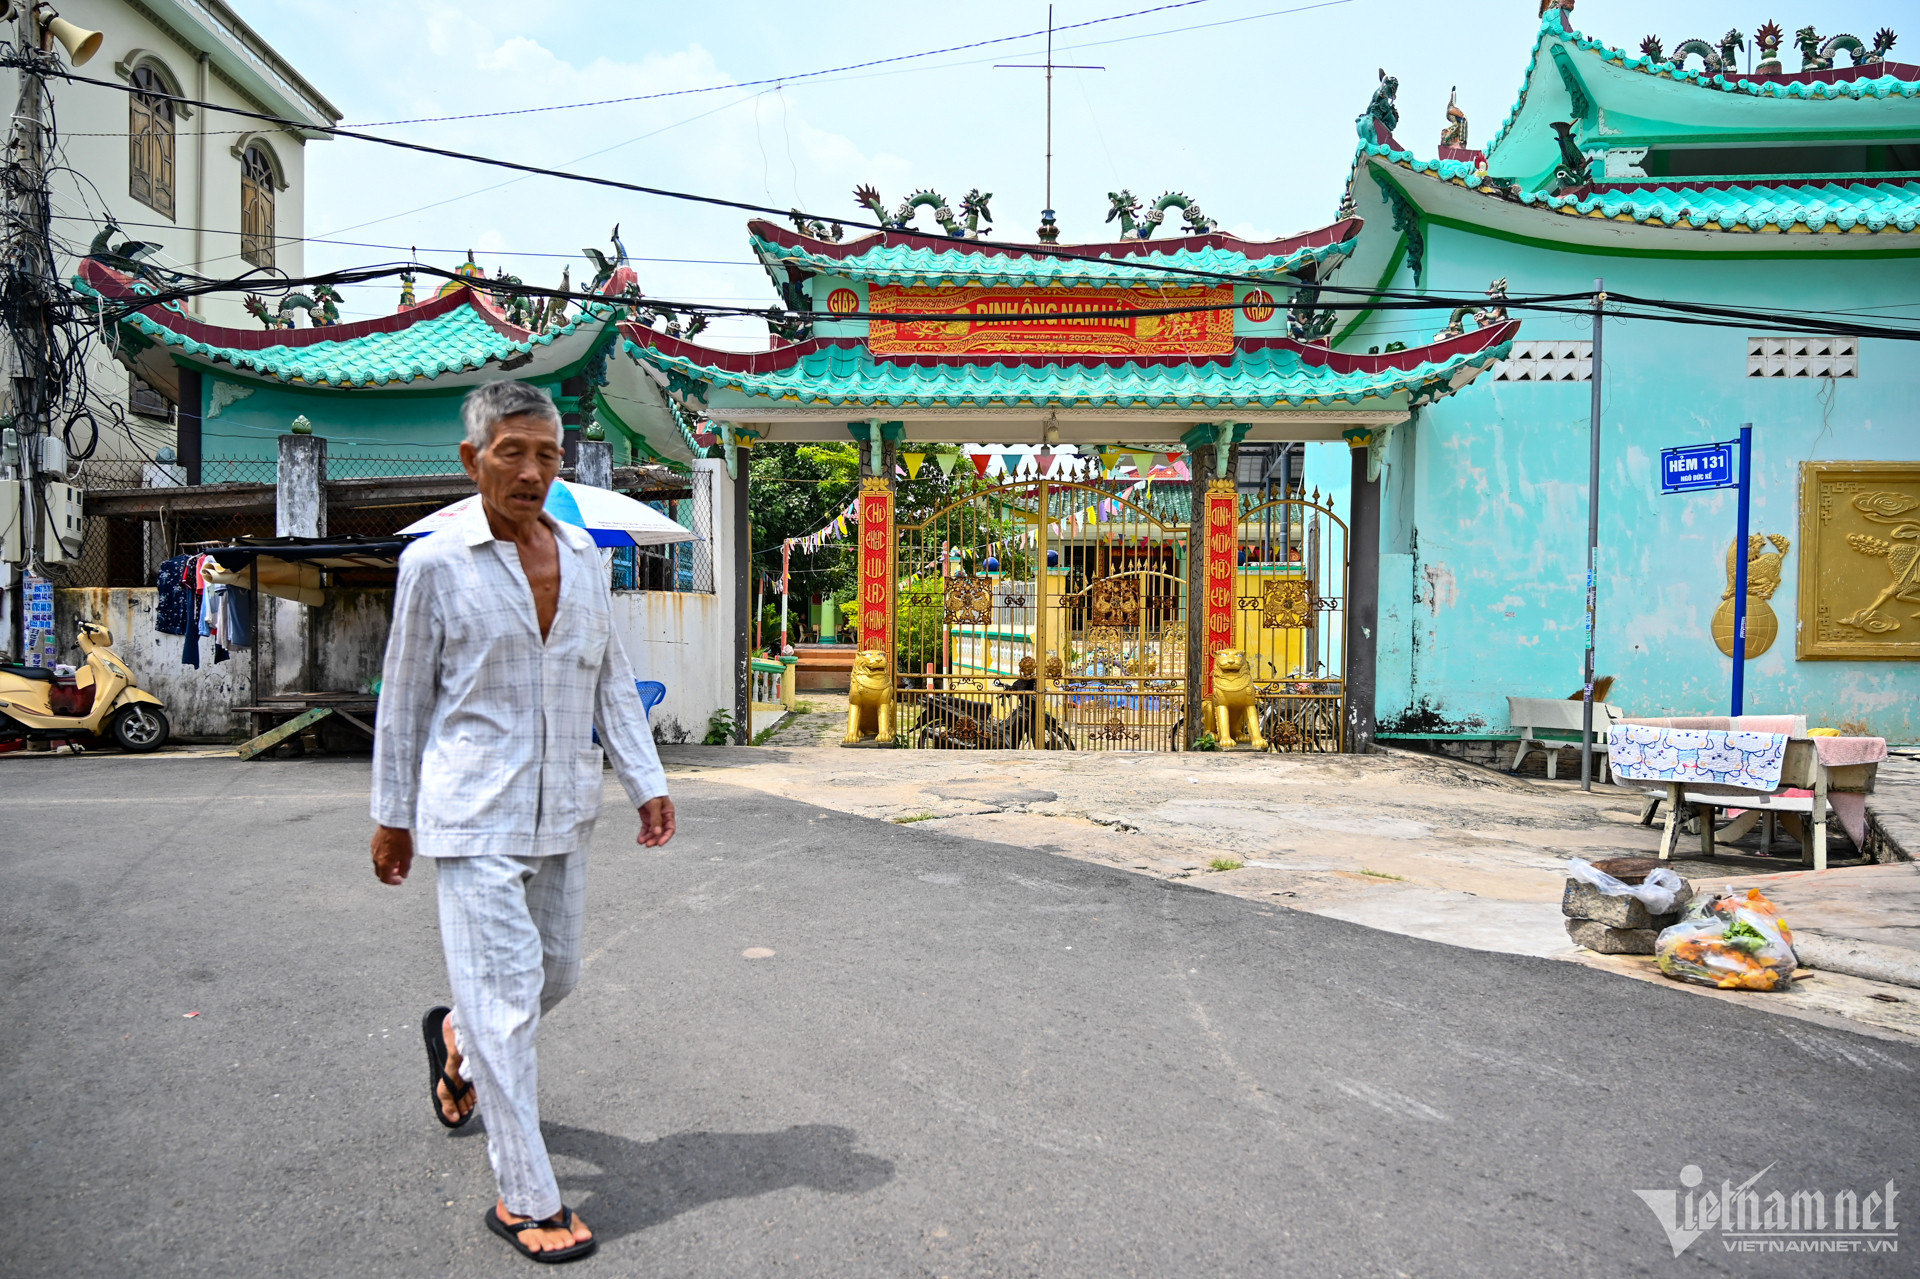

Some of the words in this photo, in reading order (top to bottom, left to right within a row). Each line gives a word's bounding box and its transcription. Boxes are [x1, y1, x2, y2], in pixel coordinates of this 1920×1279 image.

[1021, 297, 1058, 326] ÔNG
[1061, 303, 1099, 327] NAM
[1101, 299, 1130, 329] HẢI
[1669, 456, 1698, 473] HẺM
[1702, 455, 1724, 469] 131
[1693, 473, 1704, 481] ĐỨC
